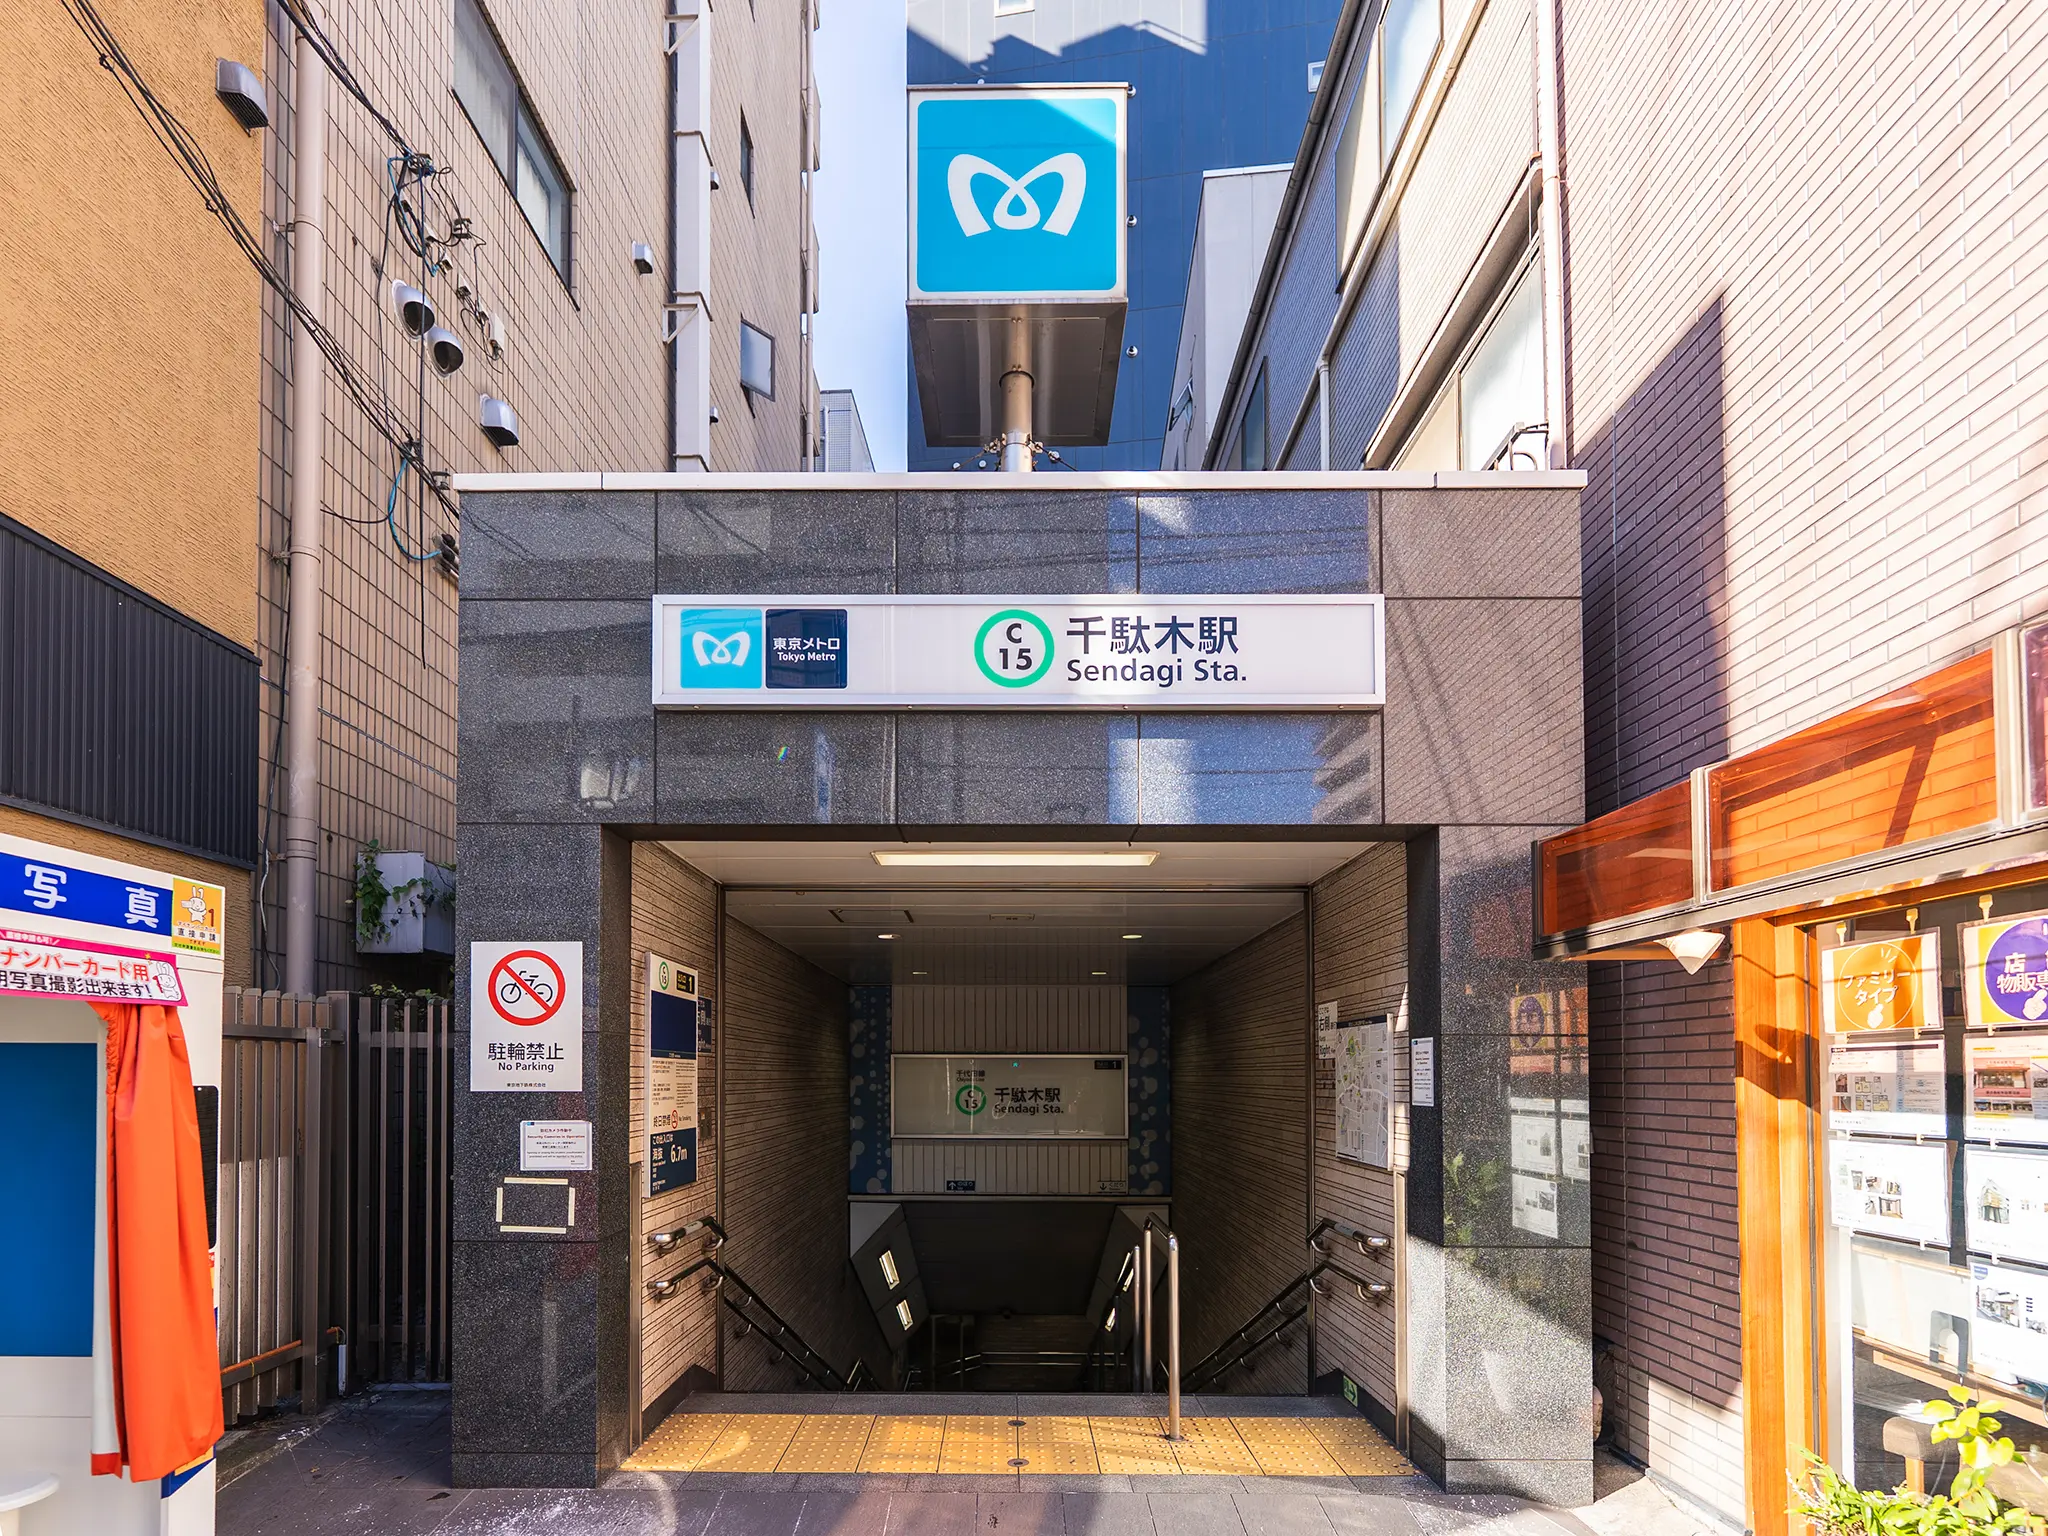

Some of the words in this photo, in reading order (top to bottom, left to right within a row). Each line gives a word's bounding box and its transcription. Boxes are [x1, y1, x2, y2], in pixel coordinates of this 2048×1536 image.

[1006, 622, 1022, 644] C
[1066, 615, 1239, 655] 千駄木駅
[773, 637, 840, 650] 東京メトロ
[777, 651, 805, 663] Tokyo
[807, 651, 836, 661] Metro
[999, 648, 1033, 671] 15
[1067, 658, 1183, 688] Sendagi
[1194, 659, 1247, 682] Sta.
[1843, 968, 1911, 989] ファミリー
[1854, 984, 1899, 1006] タイプ
[487, 1042, 565, 1061] 駐輪禁止
[498, 1062, 513, 1071] No
[515, 1061, 554, 1073] Parking
[964, 1099, 978, 1109] 15
[994, 1087, 1061, 1103] 千駄木駅
[994, 1103, 1040, 1116] Sendagi
[1043, 1103, 1064, 1114] Sta.
